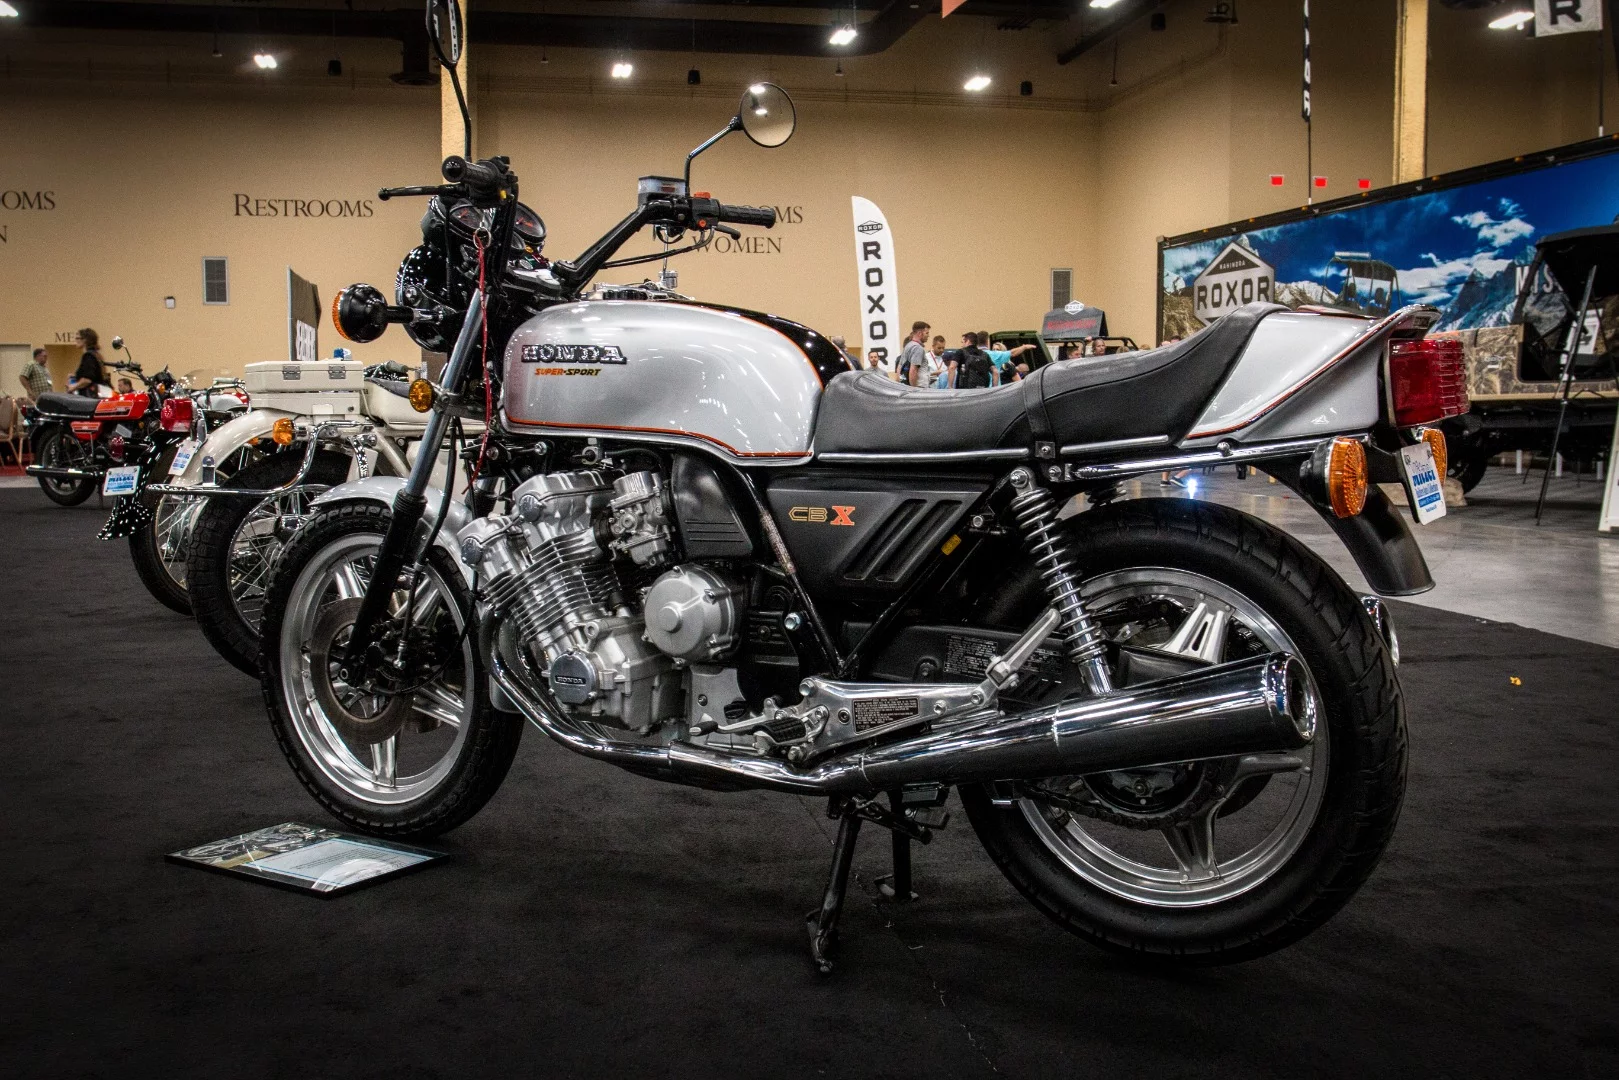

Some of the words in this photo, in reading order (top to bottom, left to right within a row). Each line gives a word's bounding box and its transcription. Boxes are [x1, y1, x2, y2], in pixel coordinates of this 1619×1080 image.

[1197, 275, 1270, 310] ROXOR
[521, 344, 627, 364] HONDA
[788, 505, 856, 526] CBX
[556, 676, 584, 684] HONDA
